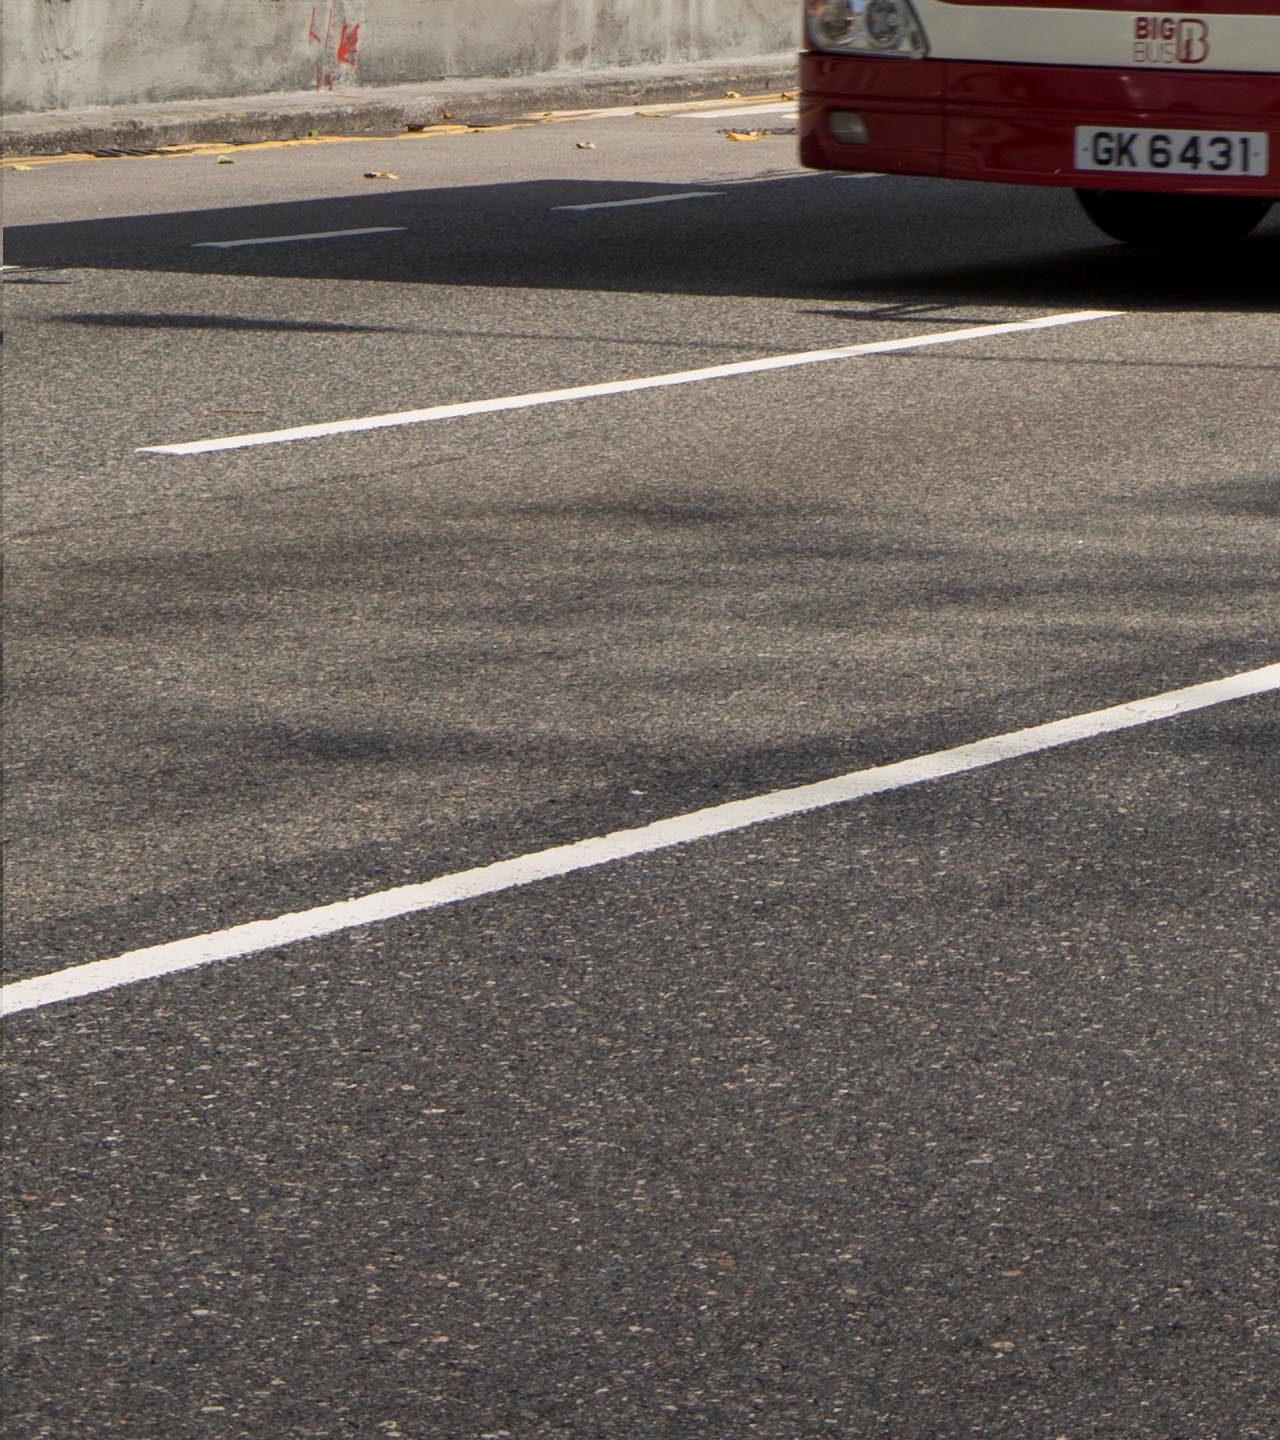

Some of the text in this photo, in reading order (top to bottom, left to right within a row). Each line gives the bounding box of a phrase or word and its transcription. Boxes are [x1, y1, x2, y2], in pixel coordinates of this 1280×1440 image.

[1135, 17, 1175, 40] BIG
[1133, 41, 1176, 63] BUS
[1092, 132, 1251, 172] GK 6431
